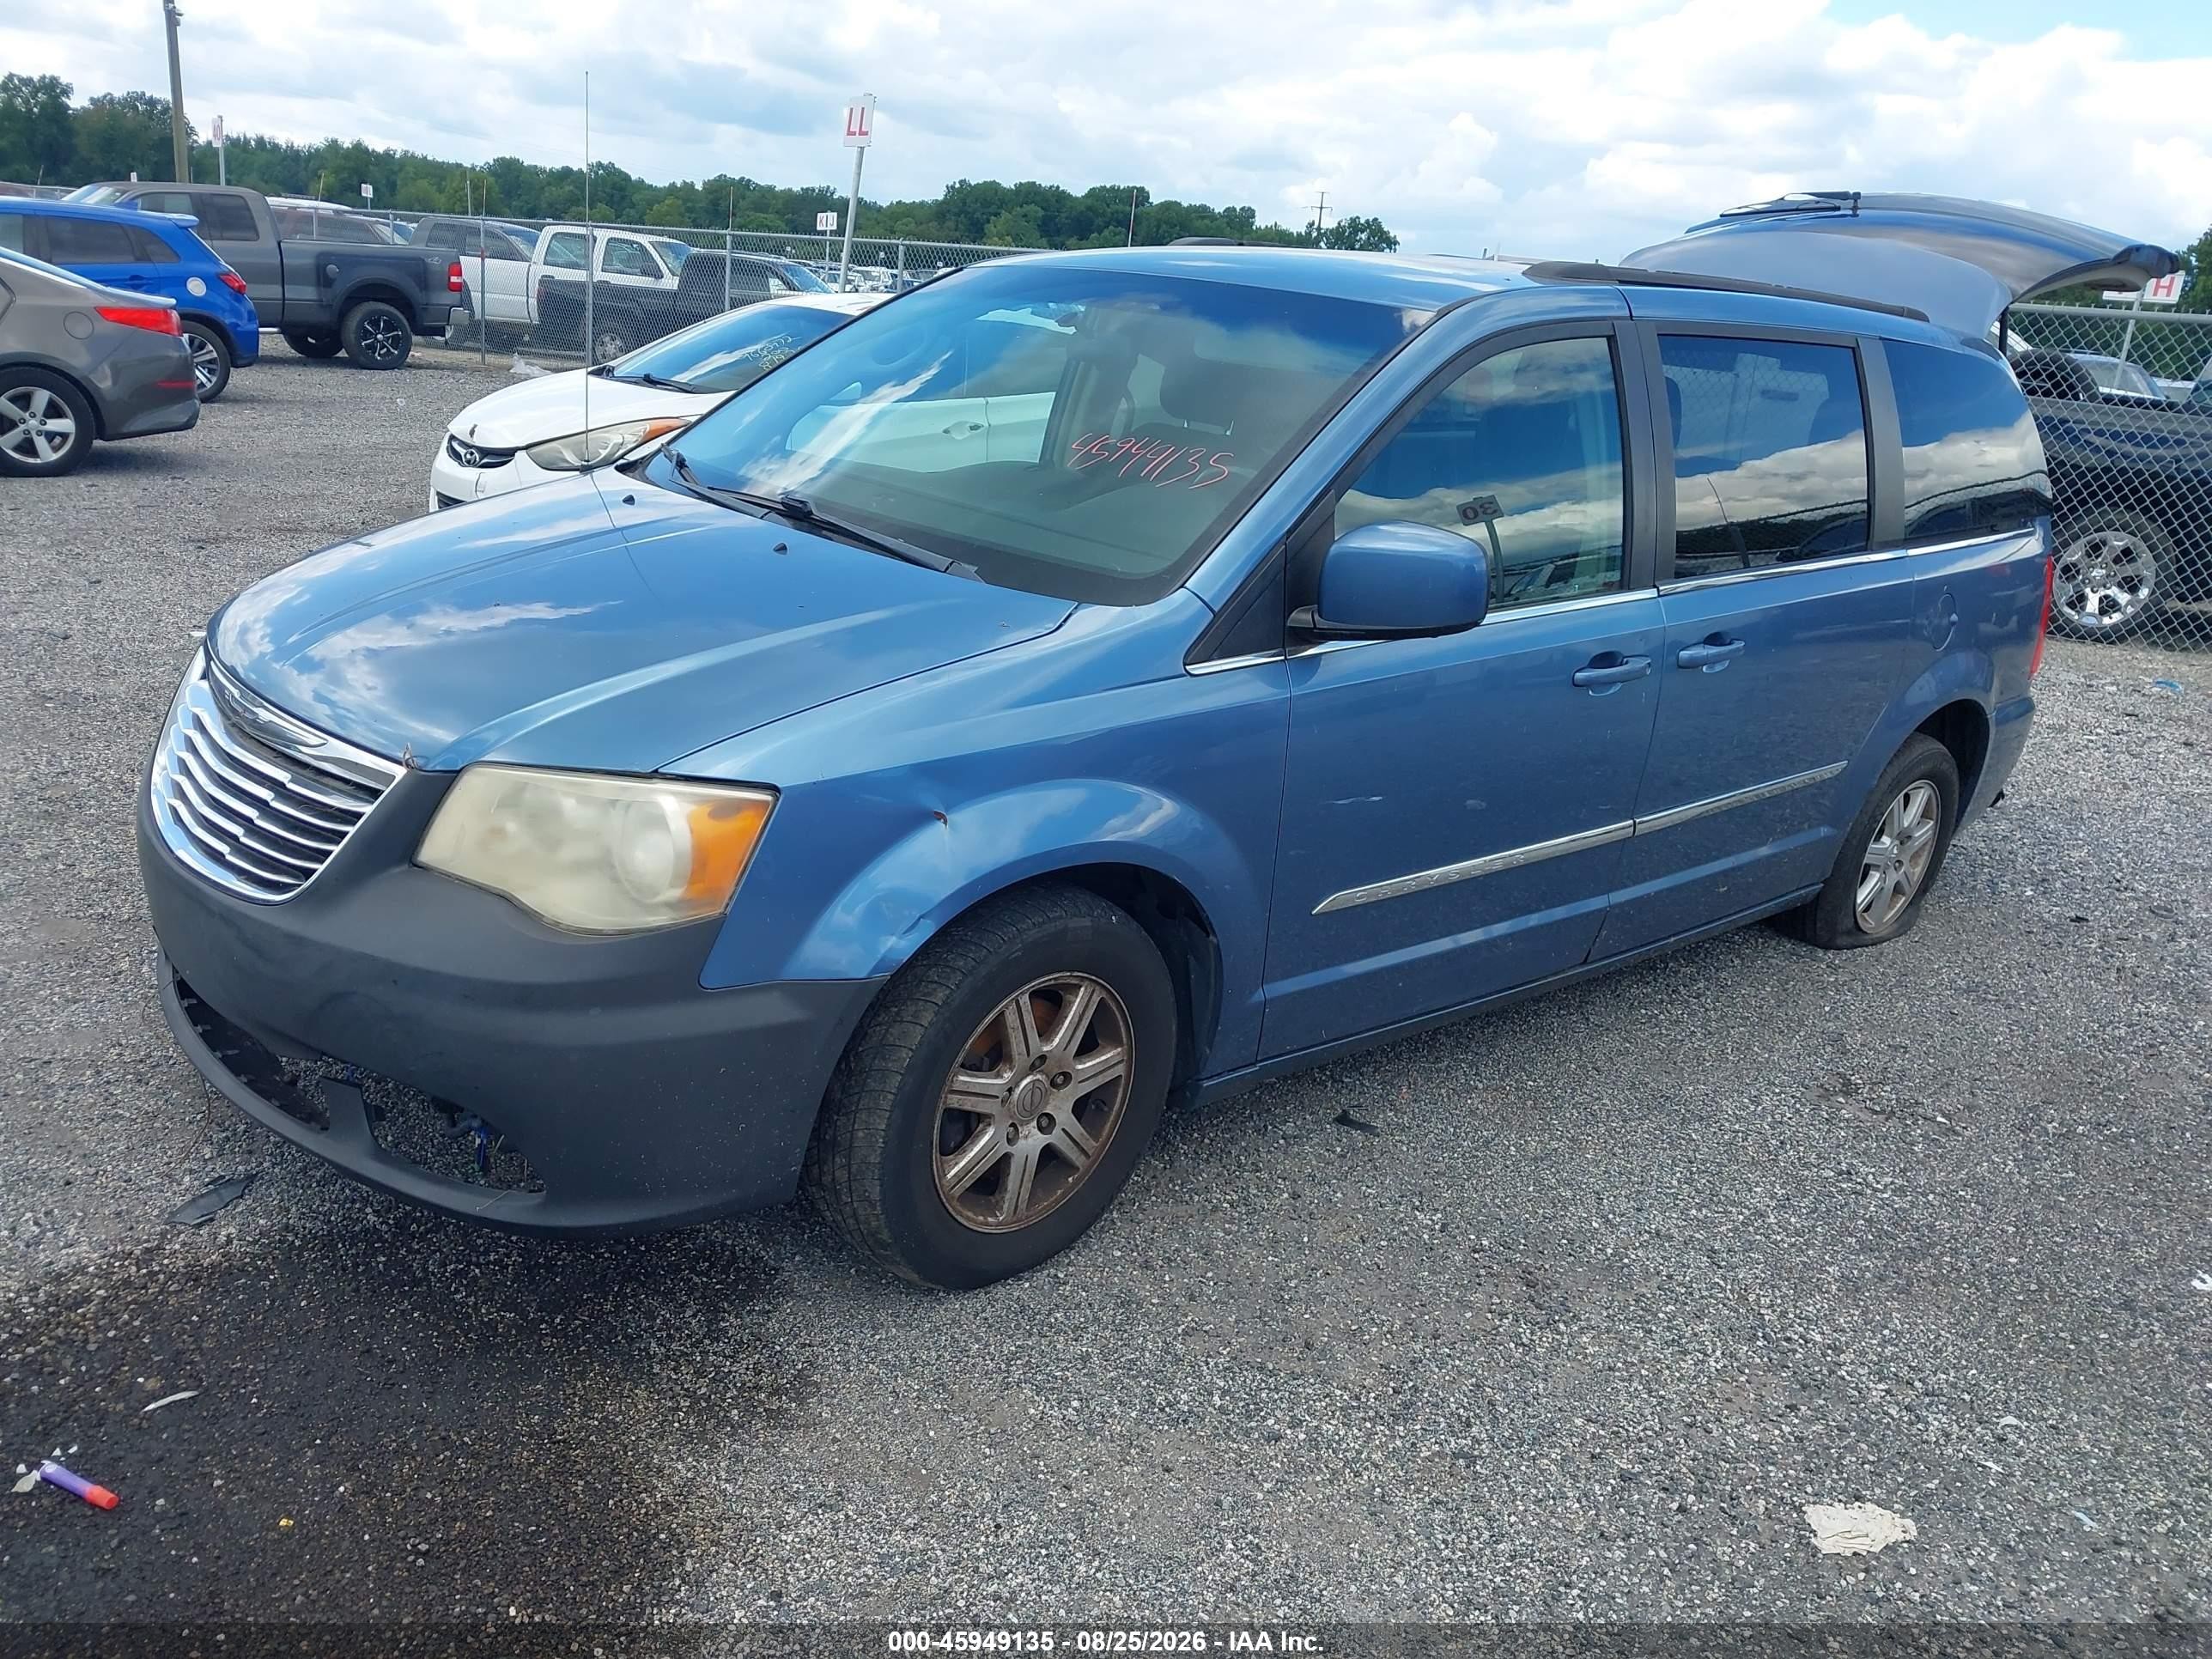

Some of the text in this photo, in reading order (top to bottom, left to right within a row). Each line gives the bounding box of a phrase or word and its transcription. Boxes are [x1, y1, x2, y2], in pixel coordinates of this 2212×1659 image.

[846, 106, 869, 137] LL
[818, 215, 825, 228] K
[2152, 276, 2176, 298] H
[1067, 433, 1235, 489] 45949135
